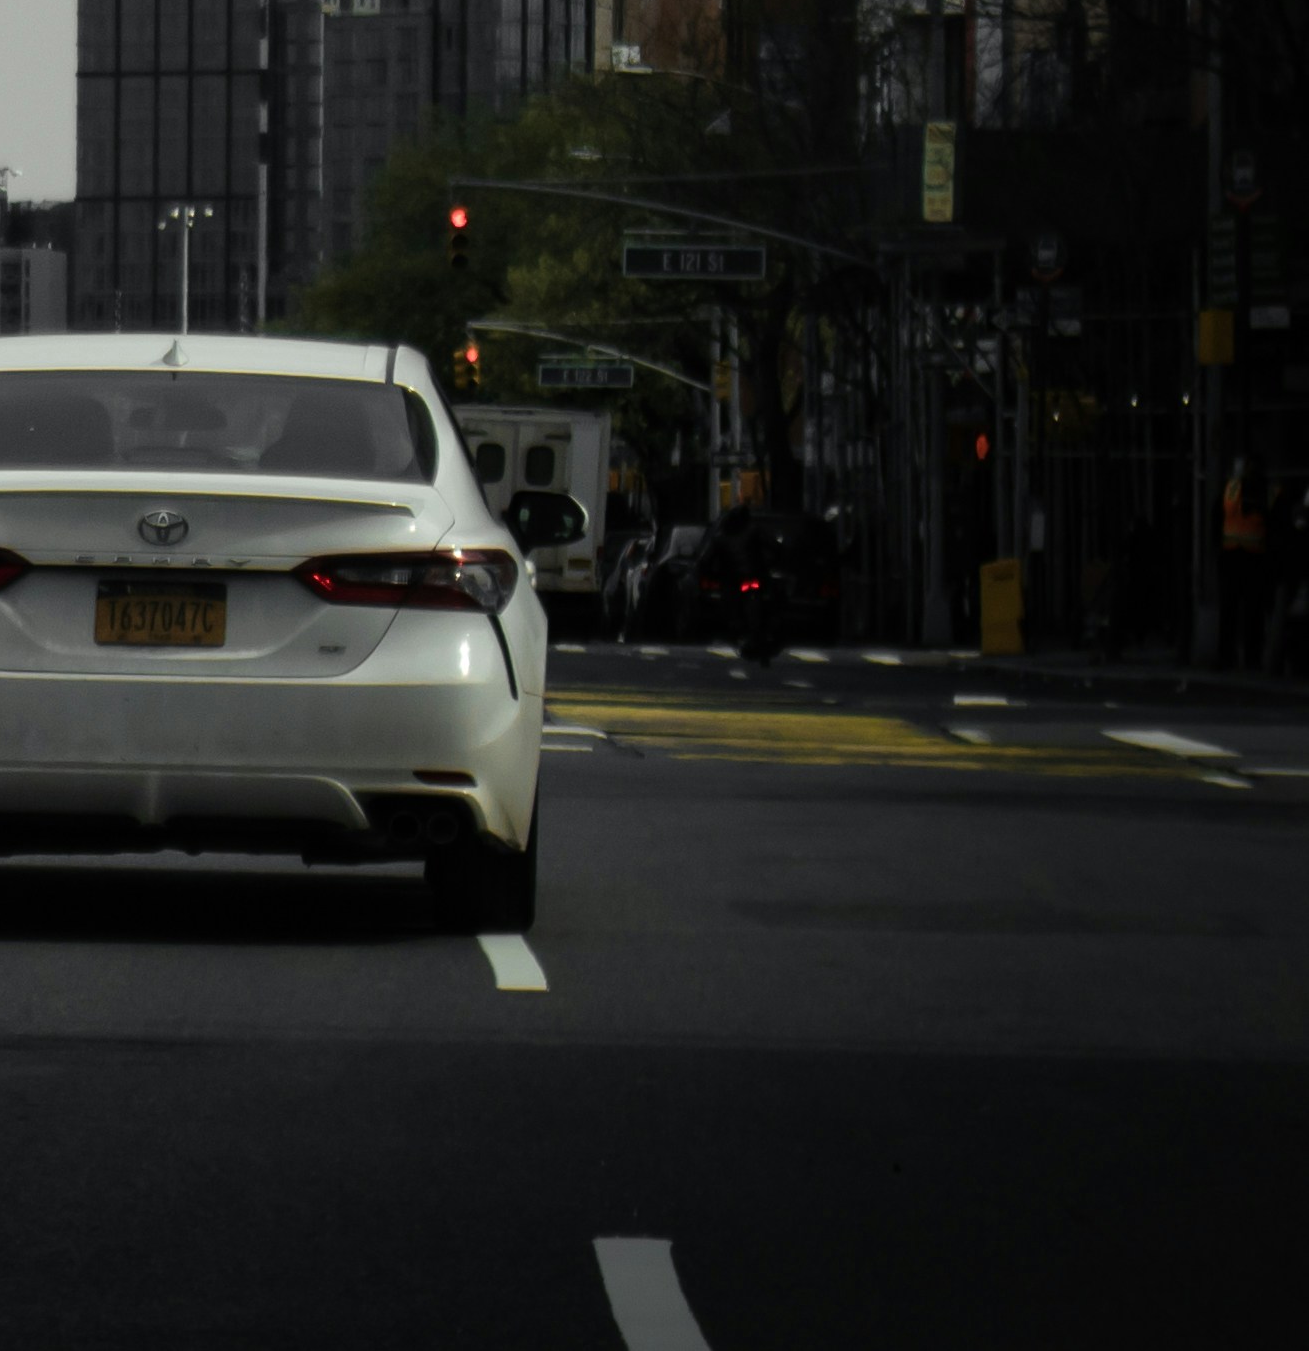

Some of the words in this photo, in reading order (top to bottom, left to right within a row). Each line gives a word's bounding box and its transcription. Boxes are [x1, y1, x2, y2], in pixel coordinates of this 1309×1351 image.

[663, 254, 672, 272] E
[708, 254, 724, 271] St
[108, 601, 214, 633] T637047C
